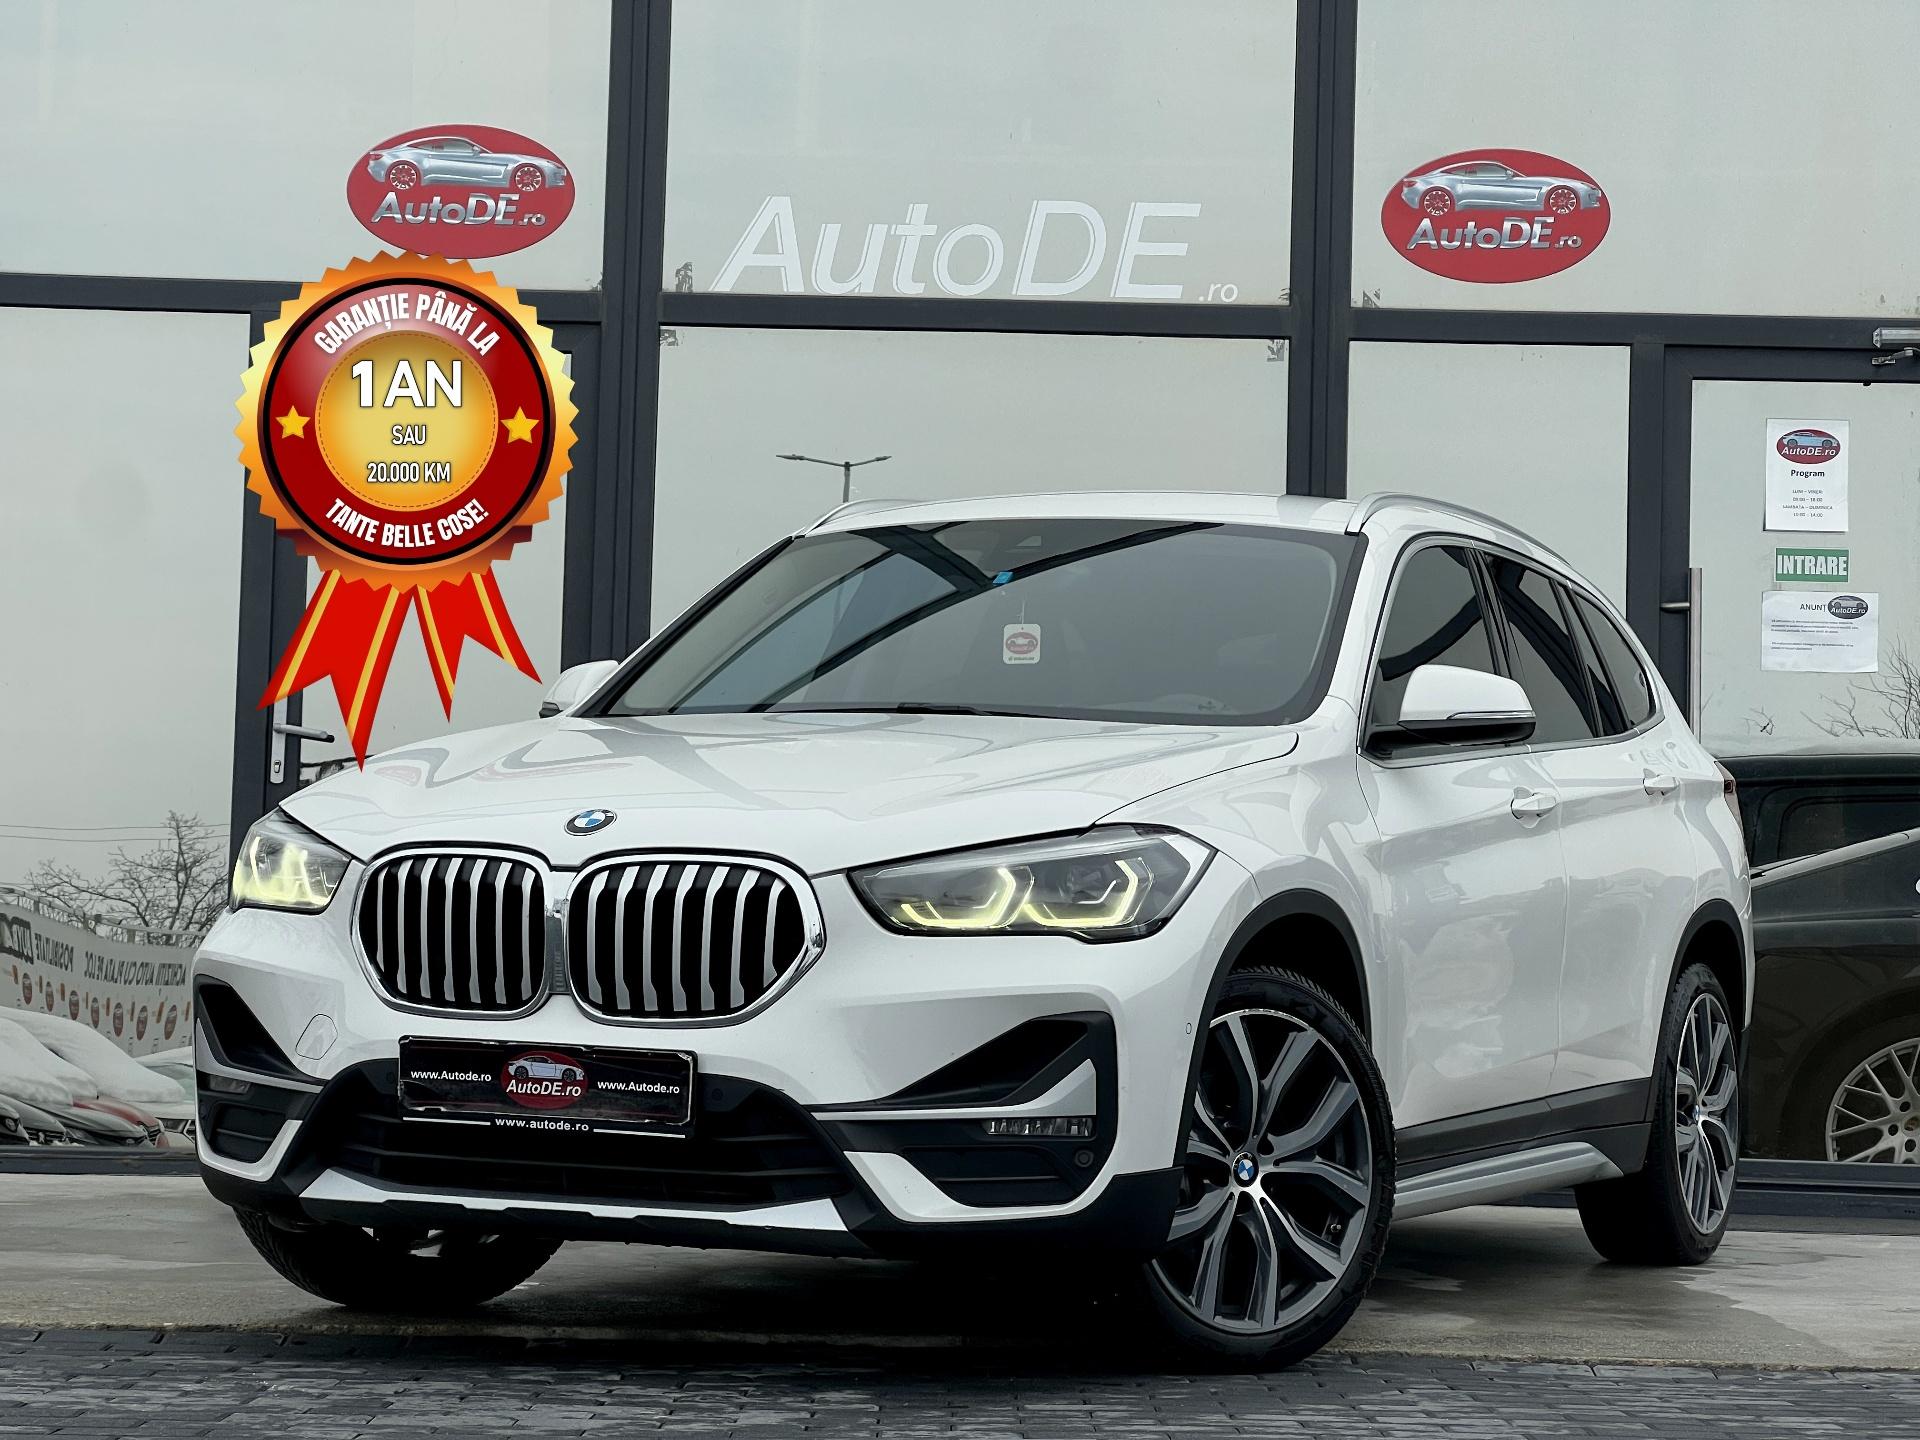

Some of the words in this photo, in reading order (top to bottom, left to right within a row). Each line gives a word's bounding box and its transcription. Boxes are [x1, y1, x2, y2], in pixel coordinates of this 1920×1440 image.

[1781, 447, 1836, 456] AutoDE.ro
[1790, 469, 1825, 478] Program
[1777, 555, 1847, 576] INTRARE
[410, 1069, 492, 1083] www.Autode.ro
[506, 1079, 582, 1097] AutoDE.ro
[597, 1080, 680, 1095] www.Autode.ro
[495, 1117, 590, 1132] www.autode.ro
